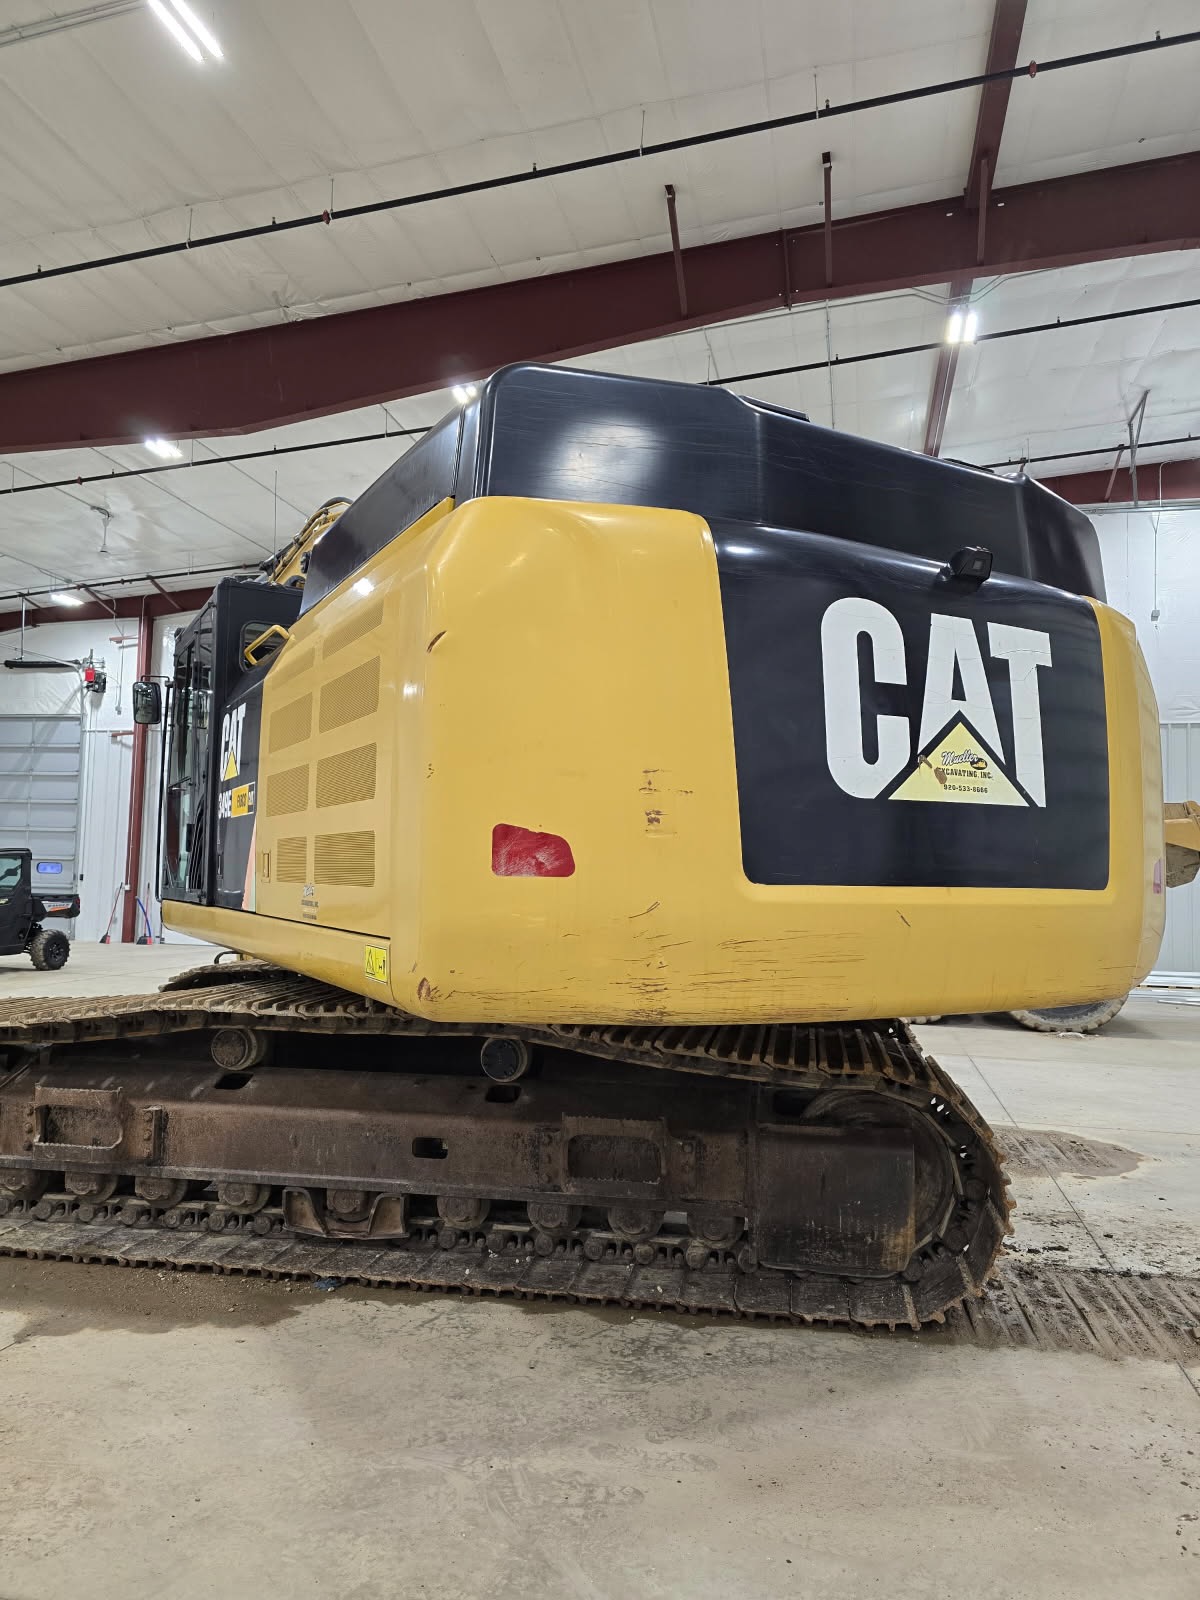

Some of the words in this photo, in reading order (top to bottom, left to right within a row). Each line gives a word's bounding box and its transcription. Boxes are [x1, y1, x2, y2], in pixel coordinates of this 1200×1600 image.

[820, 597, 1052, 807] CAT
[220, 703, 246, 781] CAT
[941, 748, 979, 766] Mueller
